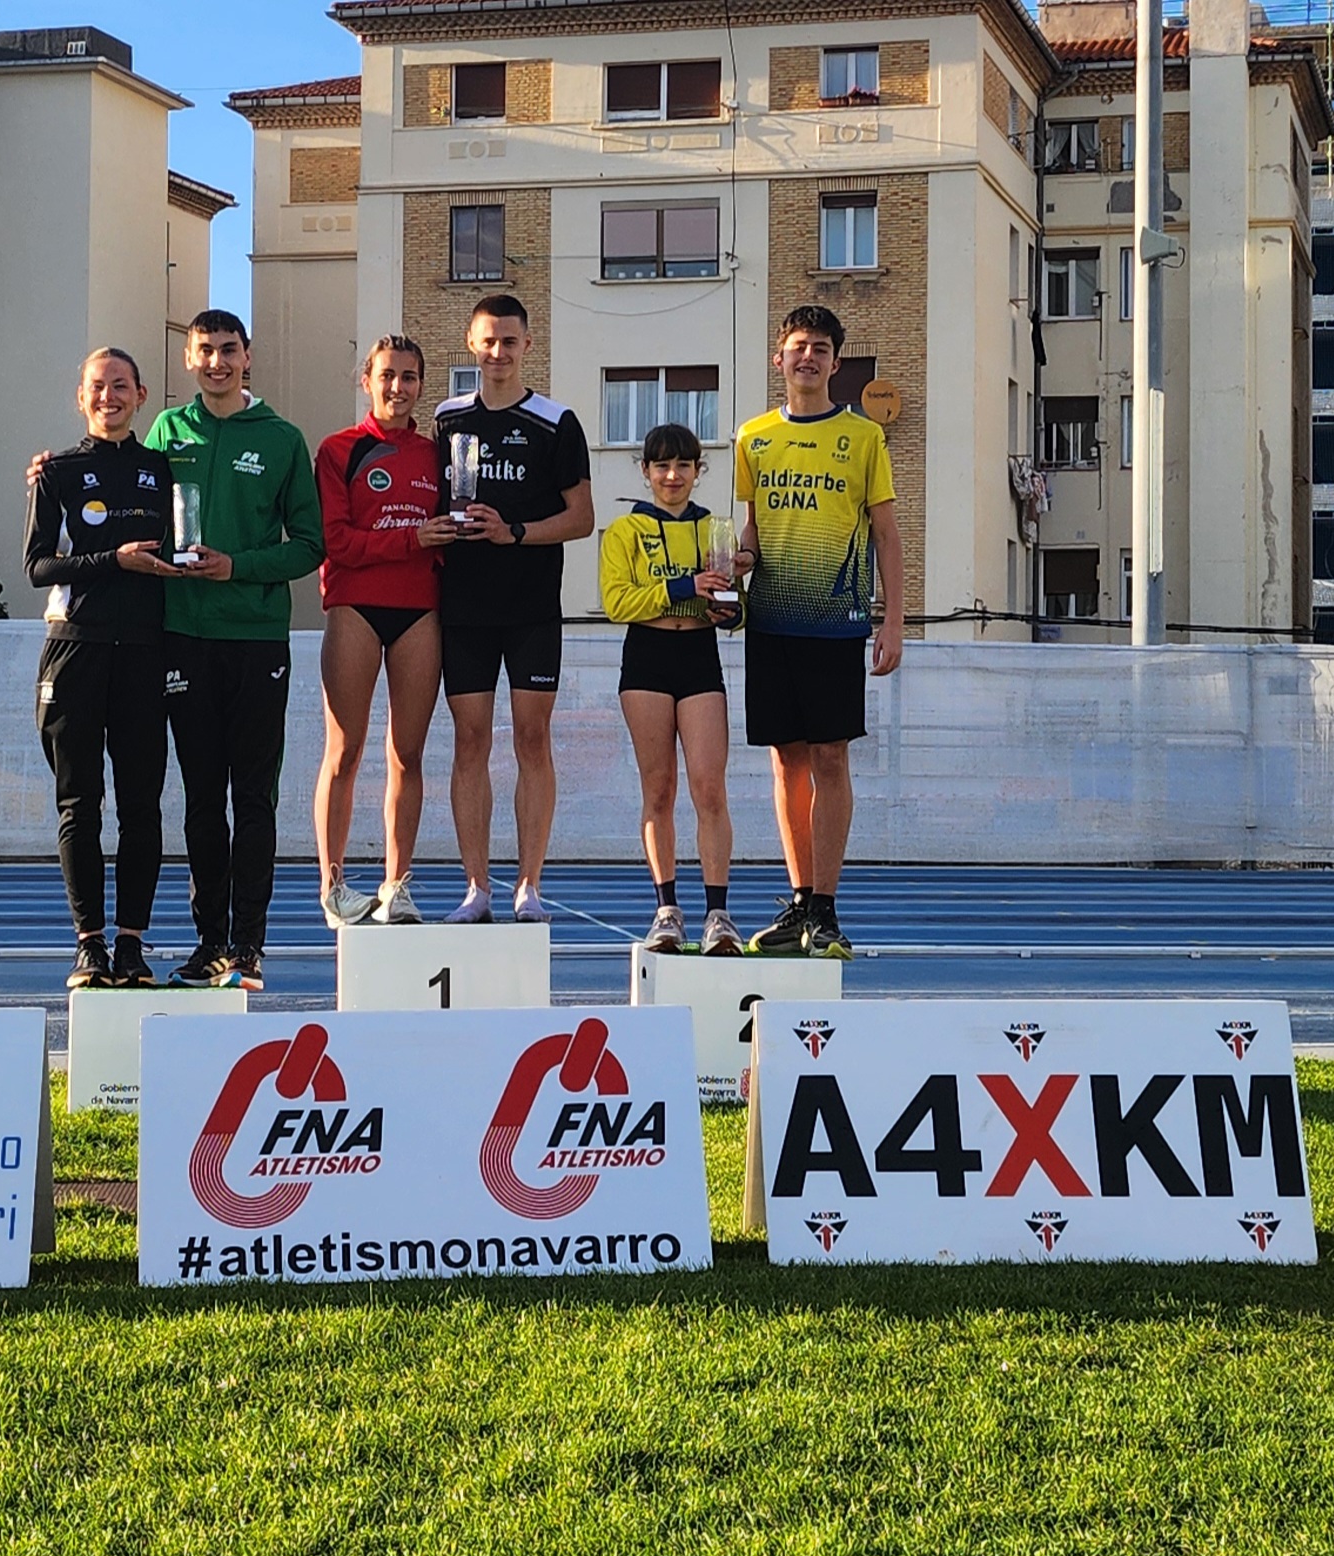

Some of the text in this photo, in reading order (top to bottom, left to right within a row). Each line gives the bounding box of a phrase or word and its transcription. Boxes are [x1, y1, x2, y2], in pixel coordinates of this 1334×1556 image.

[241, 452, 259, 463] PA
[139, 474, 155, 486] PA
[769, 491, 818, 511] GANA
[428, 967, 452, 1009] 1
[100, 1083, 139, 1092] Gobiern
[107, 1096, 139, 1104] Navarr
[261, 1107, 385, 1156] FNA
[548, 1101, 666, 1149] FNA
[771, 1073, 1306, 1198] A4XKM
[248, 1155, 383, 1178] ATLETISMO
[537, 1147, 666, 1170] ATLETISMO
[178, 1232, 681, 1279] #atletismonavarro
